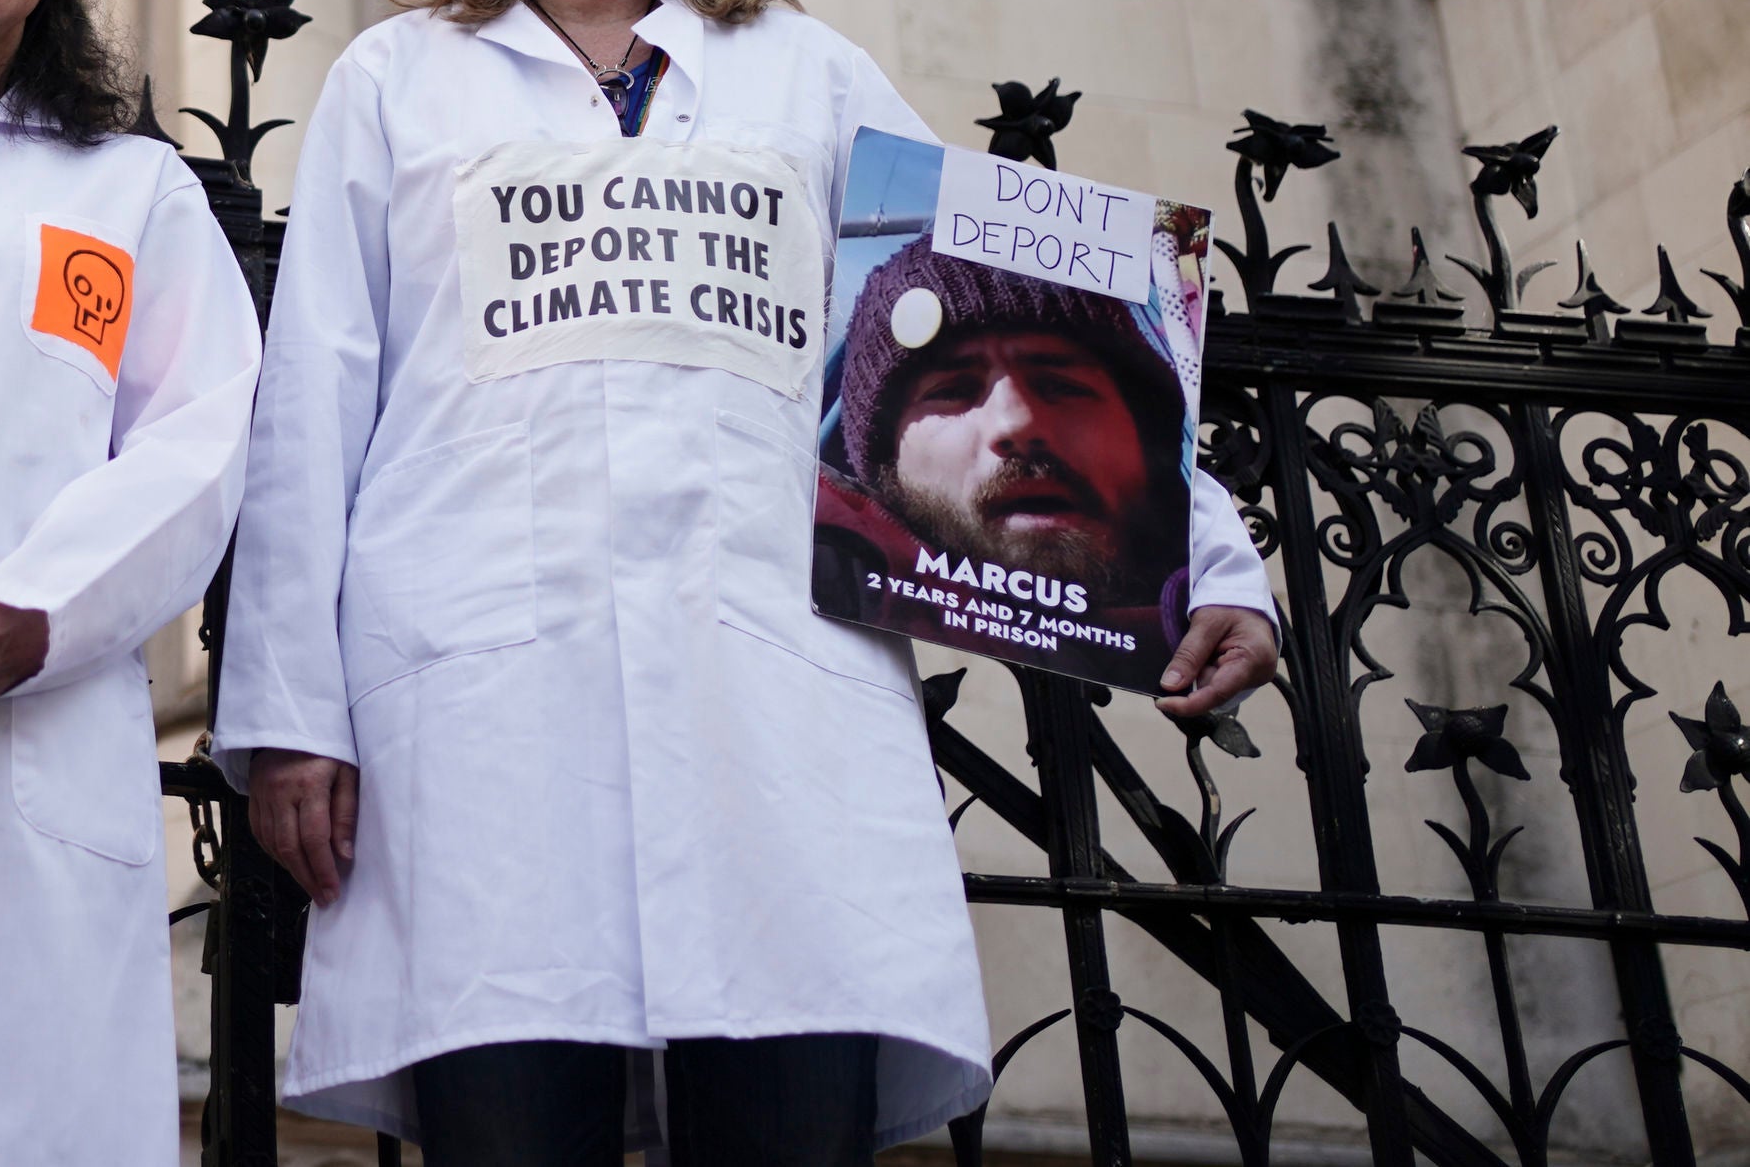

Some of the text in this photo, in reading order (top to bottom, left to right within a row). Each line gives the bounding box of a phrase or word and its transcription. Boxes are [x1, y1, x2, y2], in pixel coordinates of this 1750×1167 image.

[491, 176, 783, 226] YOU CANNOT
[997, 164, 1129, 231] DON'T
[509, 226, 769, 281] DEPORT THE
[953, 213, 1133, 289] DEPORT
[483, 279, 806, 349] CLIMATE CRISIS
[867, 573, 1136, 650] 2 YEARS AND 7 MONTHS
[915, 546, 1088, 613] MARCUS
[944, 610, 1058, 651] IN PRISON
